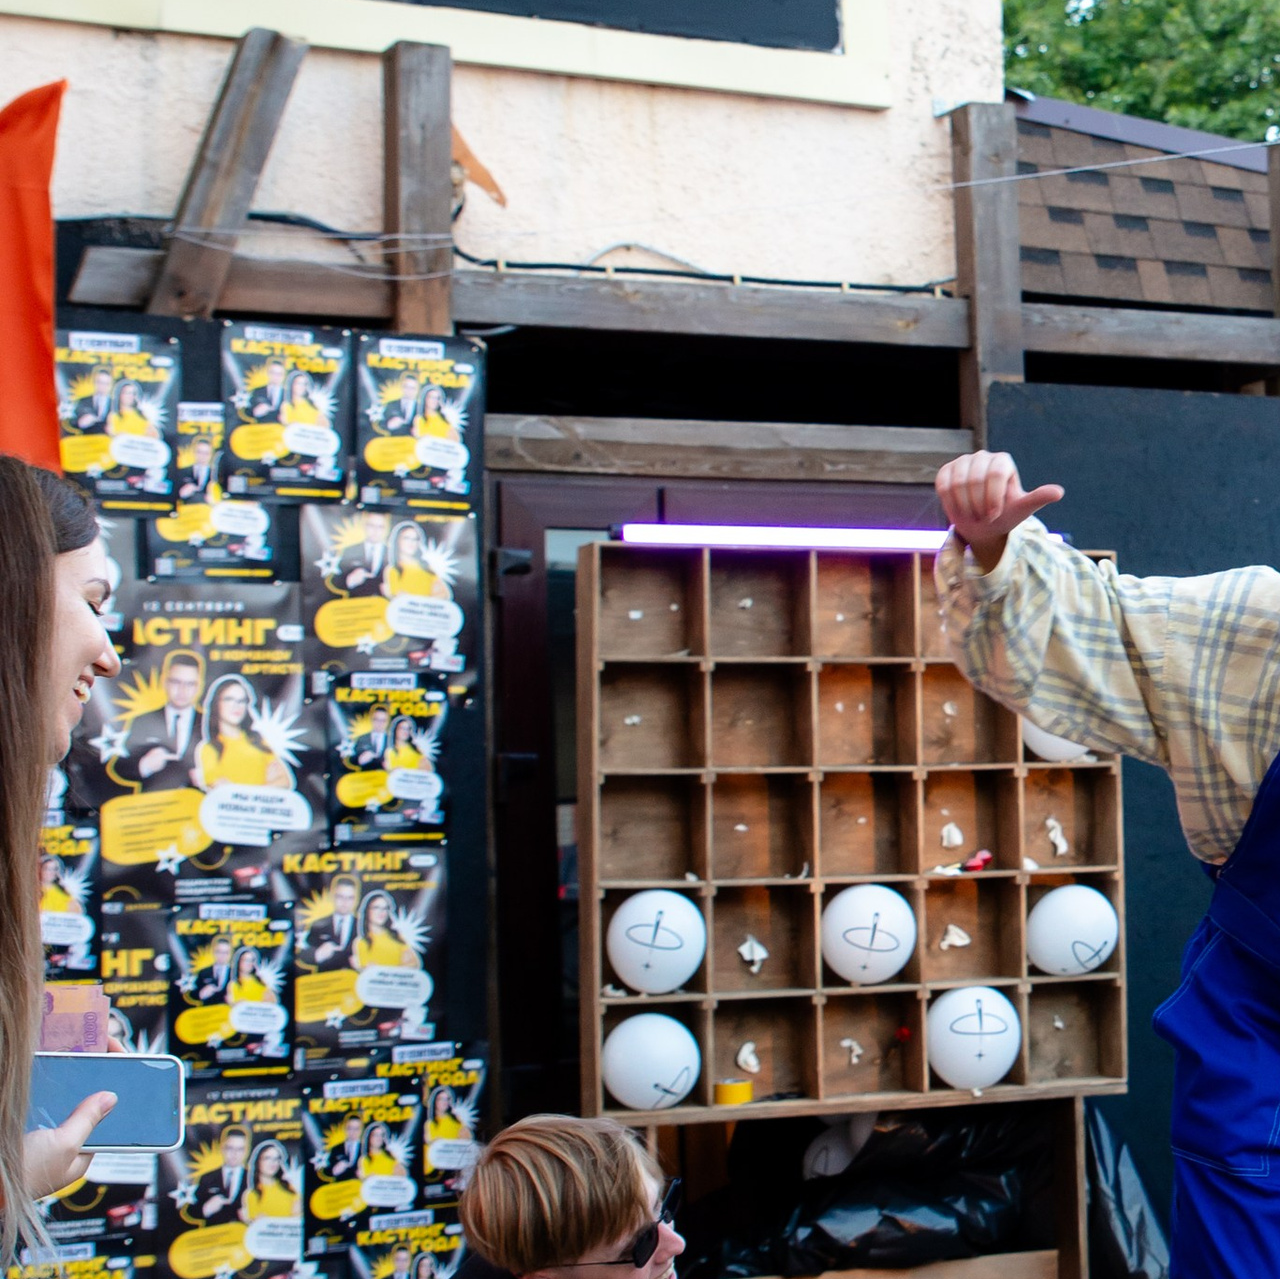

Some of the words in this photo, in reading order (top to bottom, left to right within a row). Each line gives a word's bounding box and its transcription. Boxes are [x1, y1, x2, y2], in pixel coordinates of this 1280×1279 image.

[133, 618, 277, 646] СТИНГ
[283, 850, 410, 874] КАСТИНГ
[83, 1011, 98, 1047] 1000
